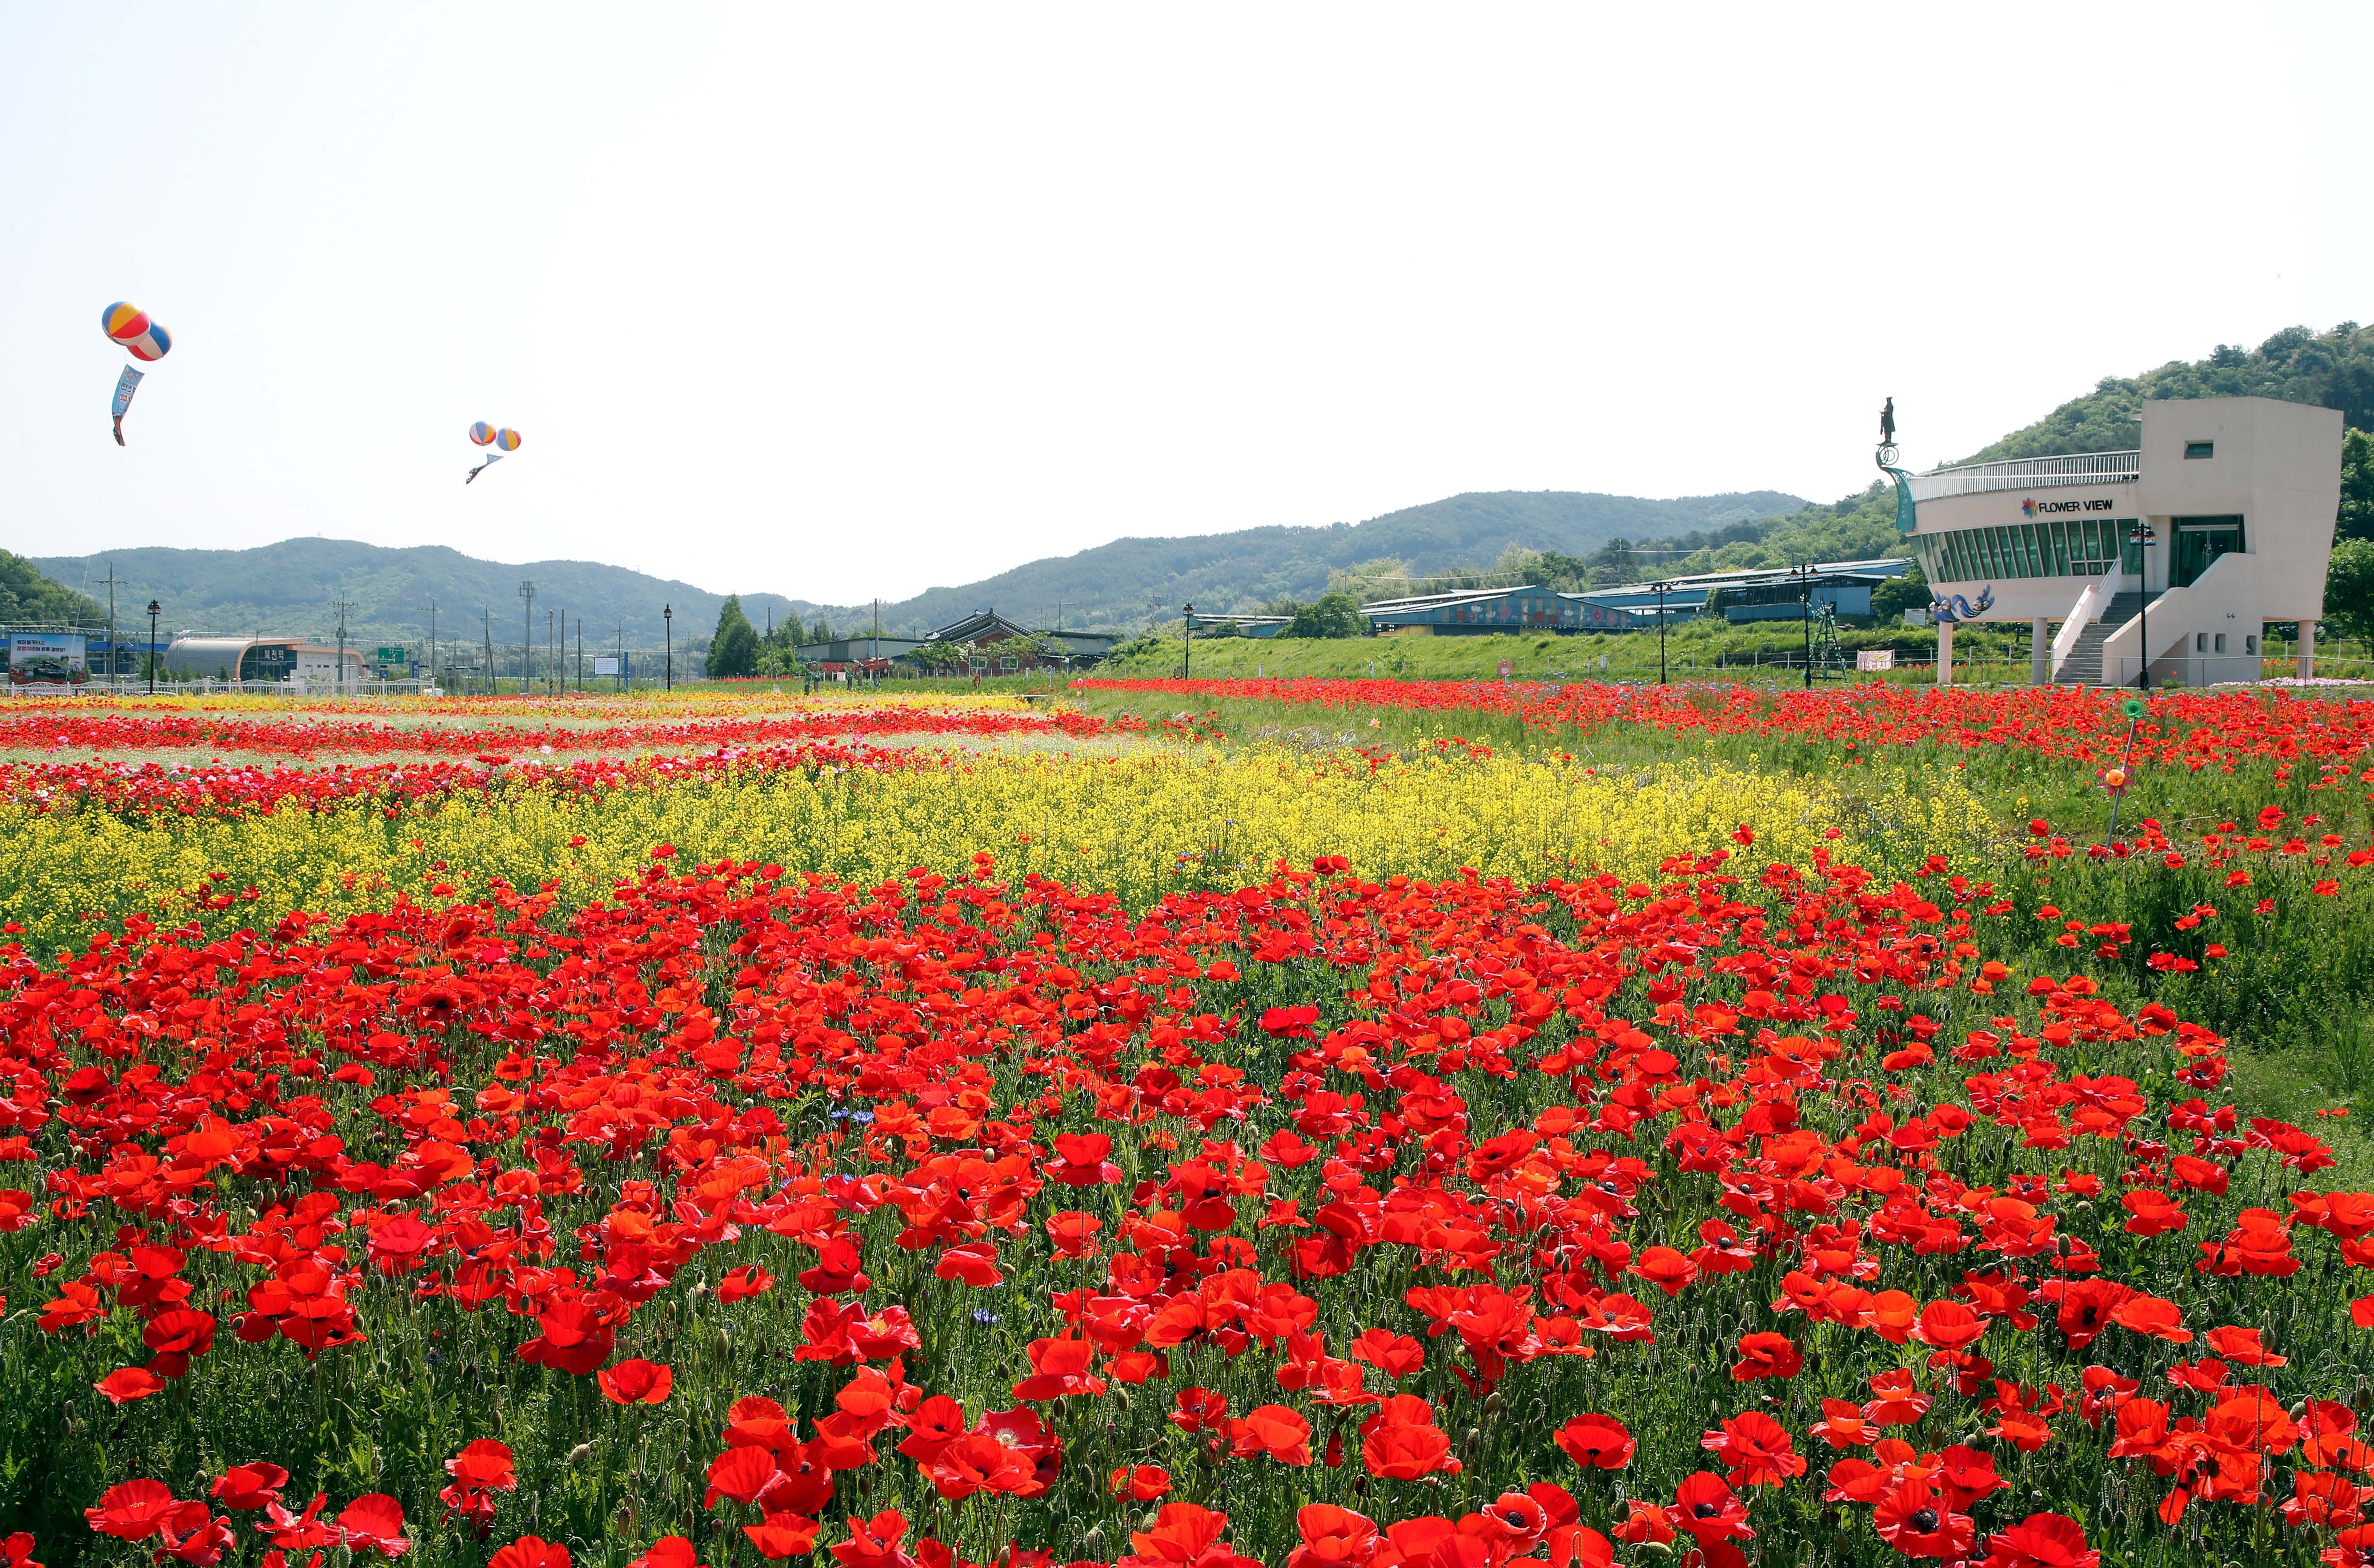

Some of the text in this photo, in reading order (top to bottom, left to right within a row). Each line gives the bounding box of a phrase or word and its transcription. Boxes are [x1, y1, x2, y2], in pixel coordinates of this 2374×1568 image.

[2038, 499, 2113, 512] FLOWER VIEW
[265, 650, 284, 660] 북천역
